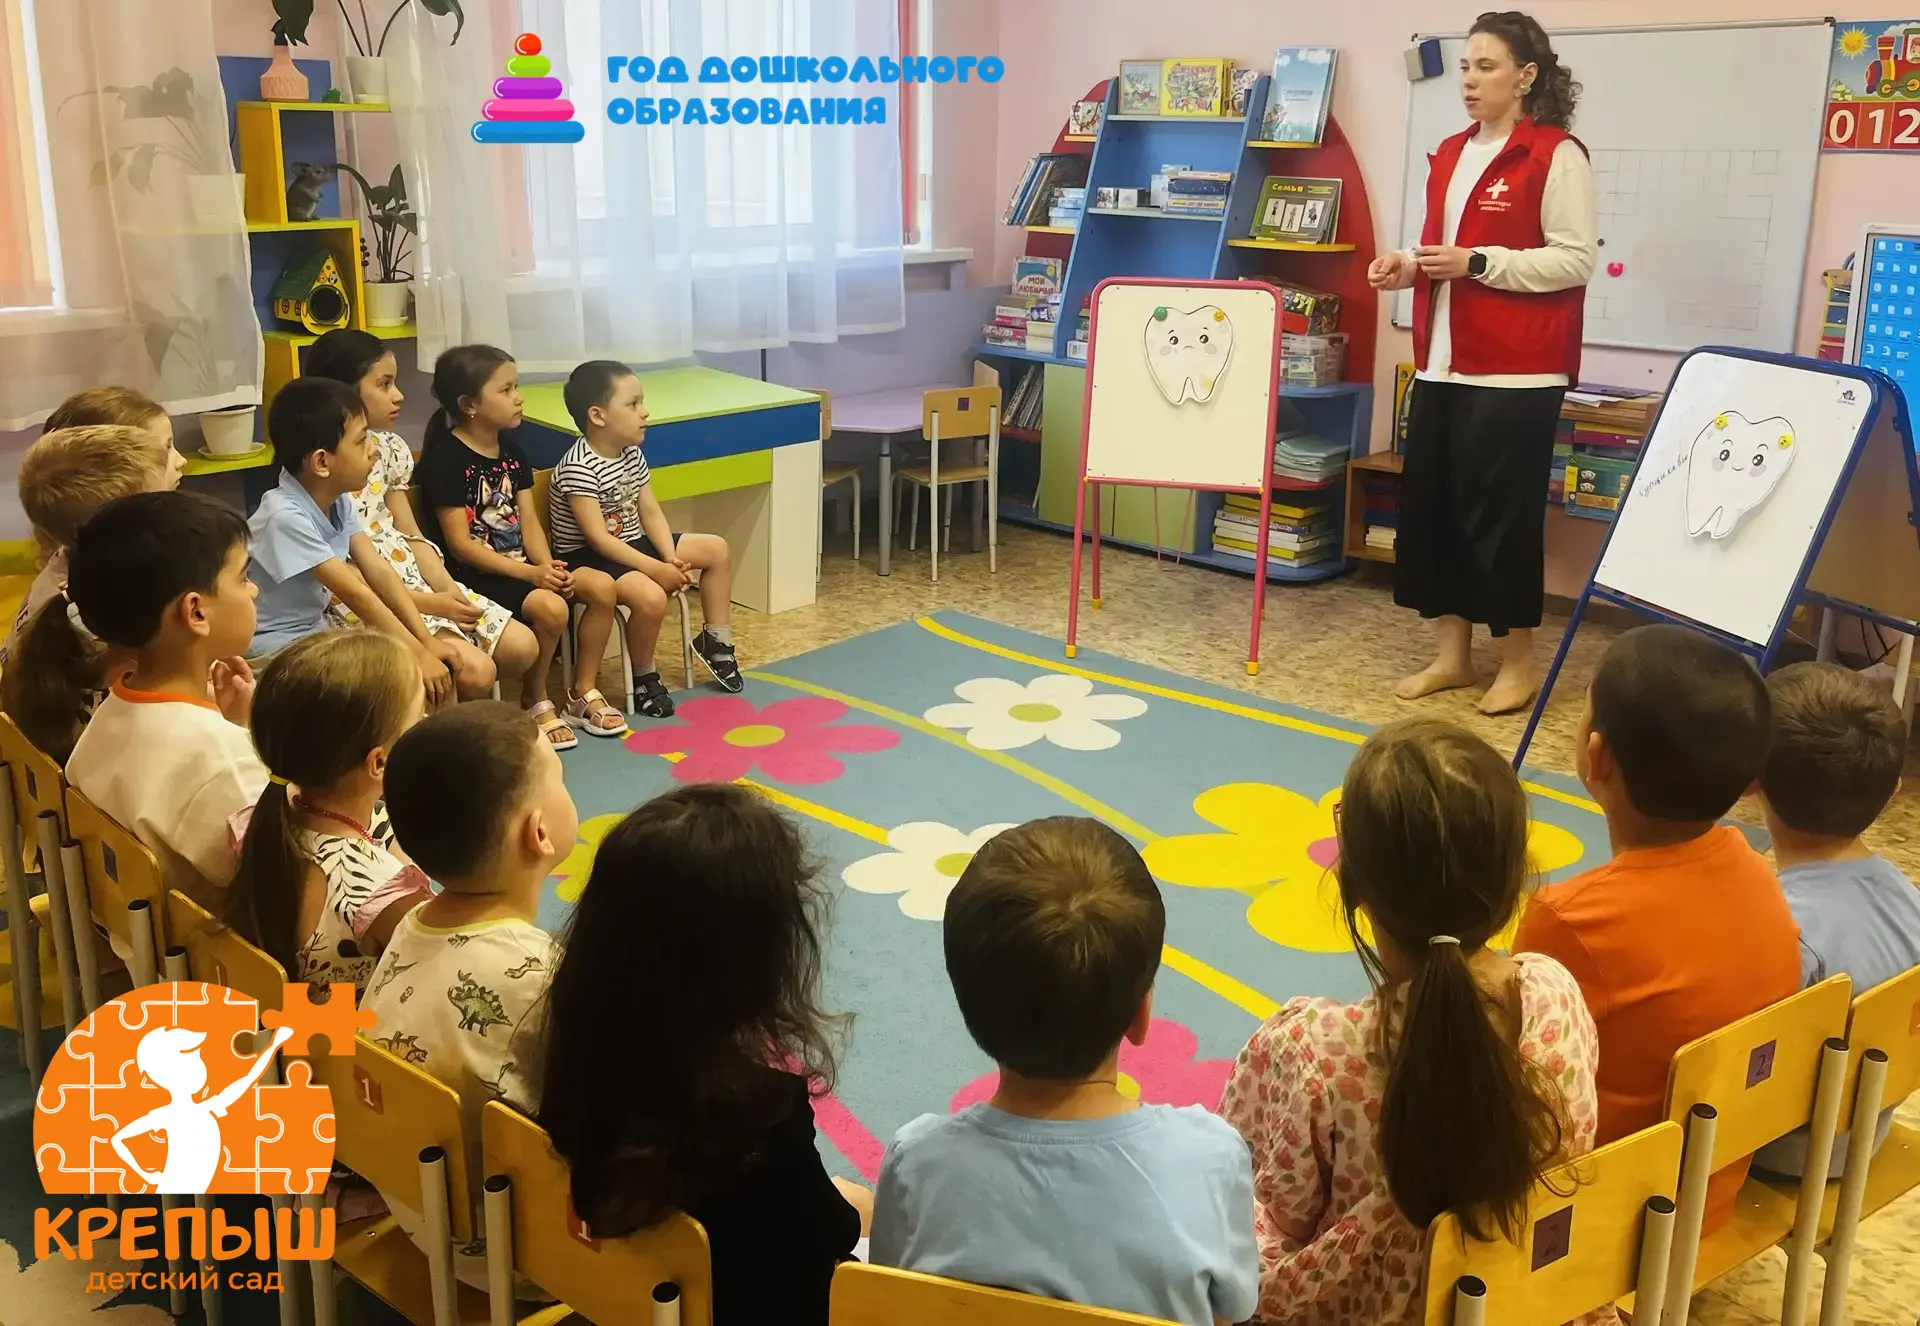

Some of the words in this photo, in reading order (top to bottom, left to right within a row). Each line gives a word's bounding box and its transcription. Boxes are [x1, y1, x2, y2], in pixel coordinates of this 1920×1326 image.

[1829, 109, 1855, 144] 0
[1868, 108, 1885, 144] 1
[1893, 108, 1920, 144] 2
[1272, 183, 1304, 193] Семья
[1755, 1054, 1766, 1076] 2
[359, 1077, 377, 1108] 1
